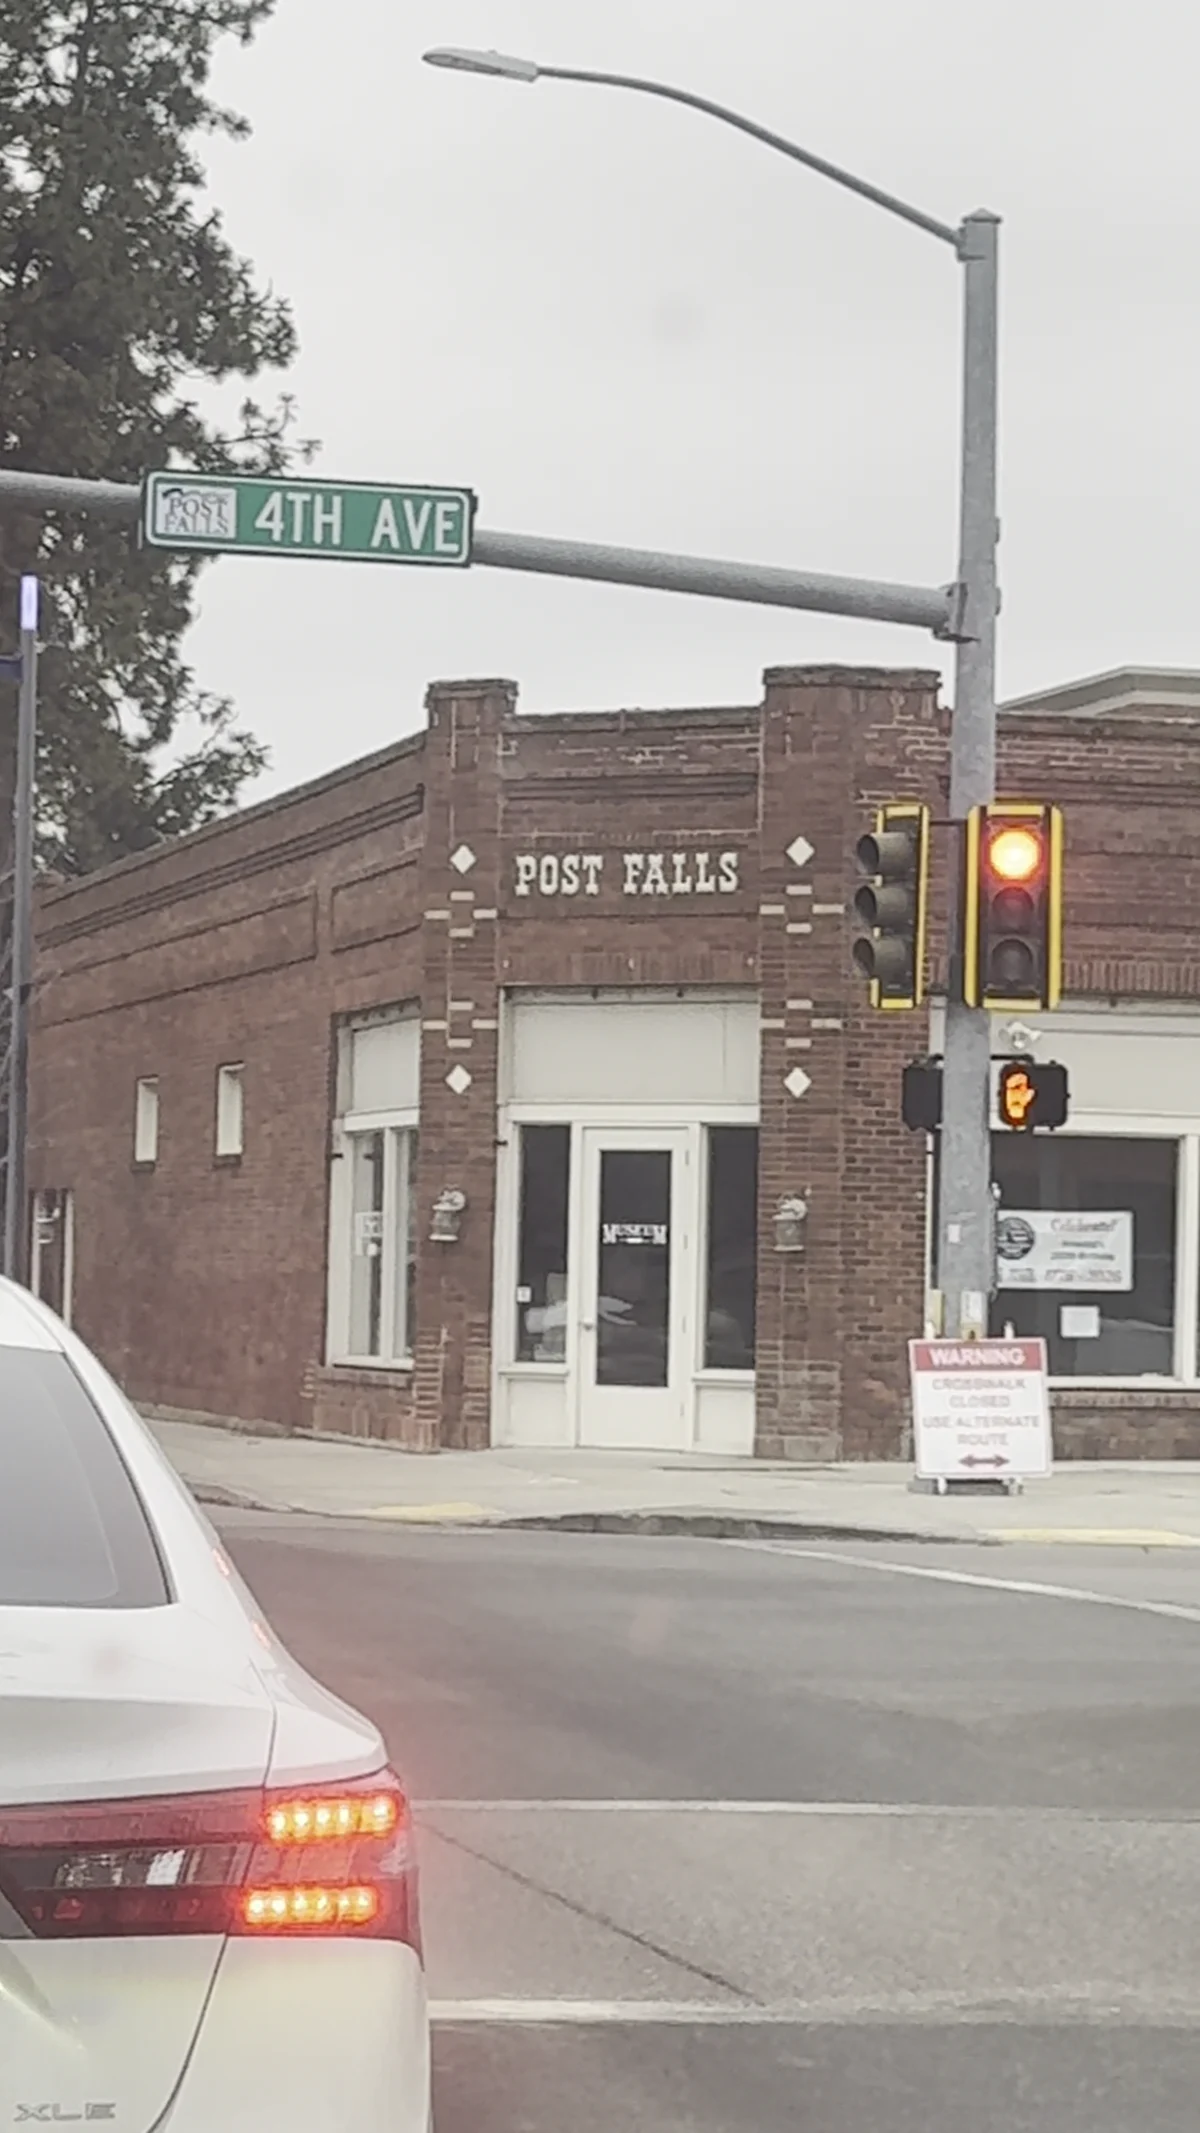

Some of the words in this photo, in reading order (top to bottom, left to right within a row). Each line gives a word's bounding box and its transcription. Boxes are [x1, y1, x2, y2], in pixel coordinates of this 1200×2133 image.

[169, 497, 228, 520] POST
[164, 514, 229, 537] FALLS
[254, 491, 341, 545] 4TH
[371, 498, 460, 554] AVE
[515, 854, 603, 896] POST
[623, 852, 738, 895] FALLS
[929, 1348, 1026, 1366] WARNING
[950, 1395, 1010, 1408] CLOSED
[922, 1416, 952, 1428] USE
[956, 1416, 1039, 1428] ALTERNATE
[957, 1433, 1008, 1445] ROUTE
[13, 2102, 116, 2122] XLE
